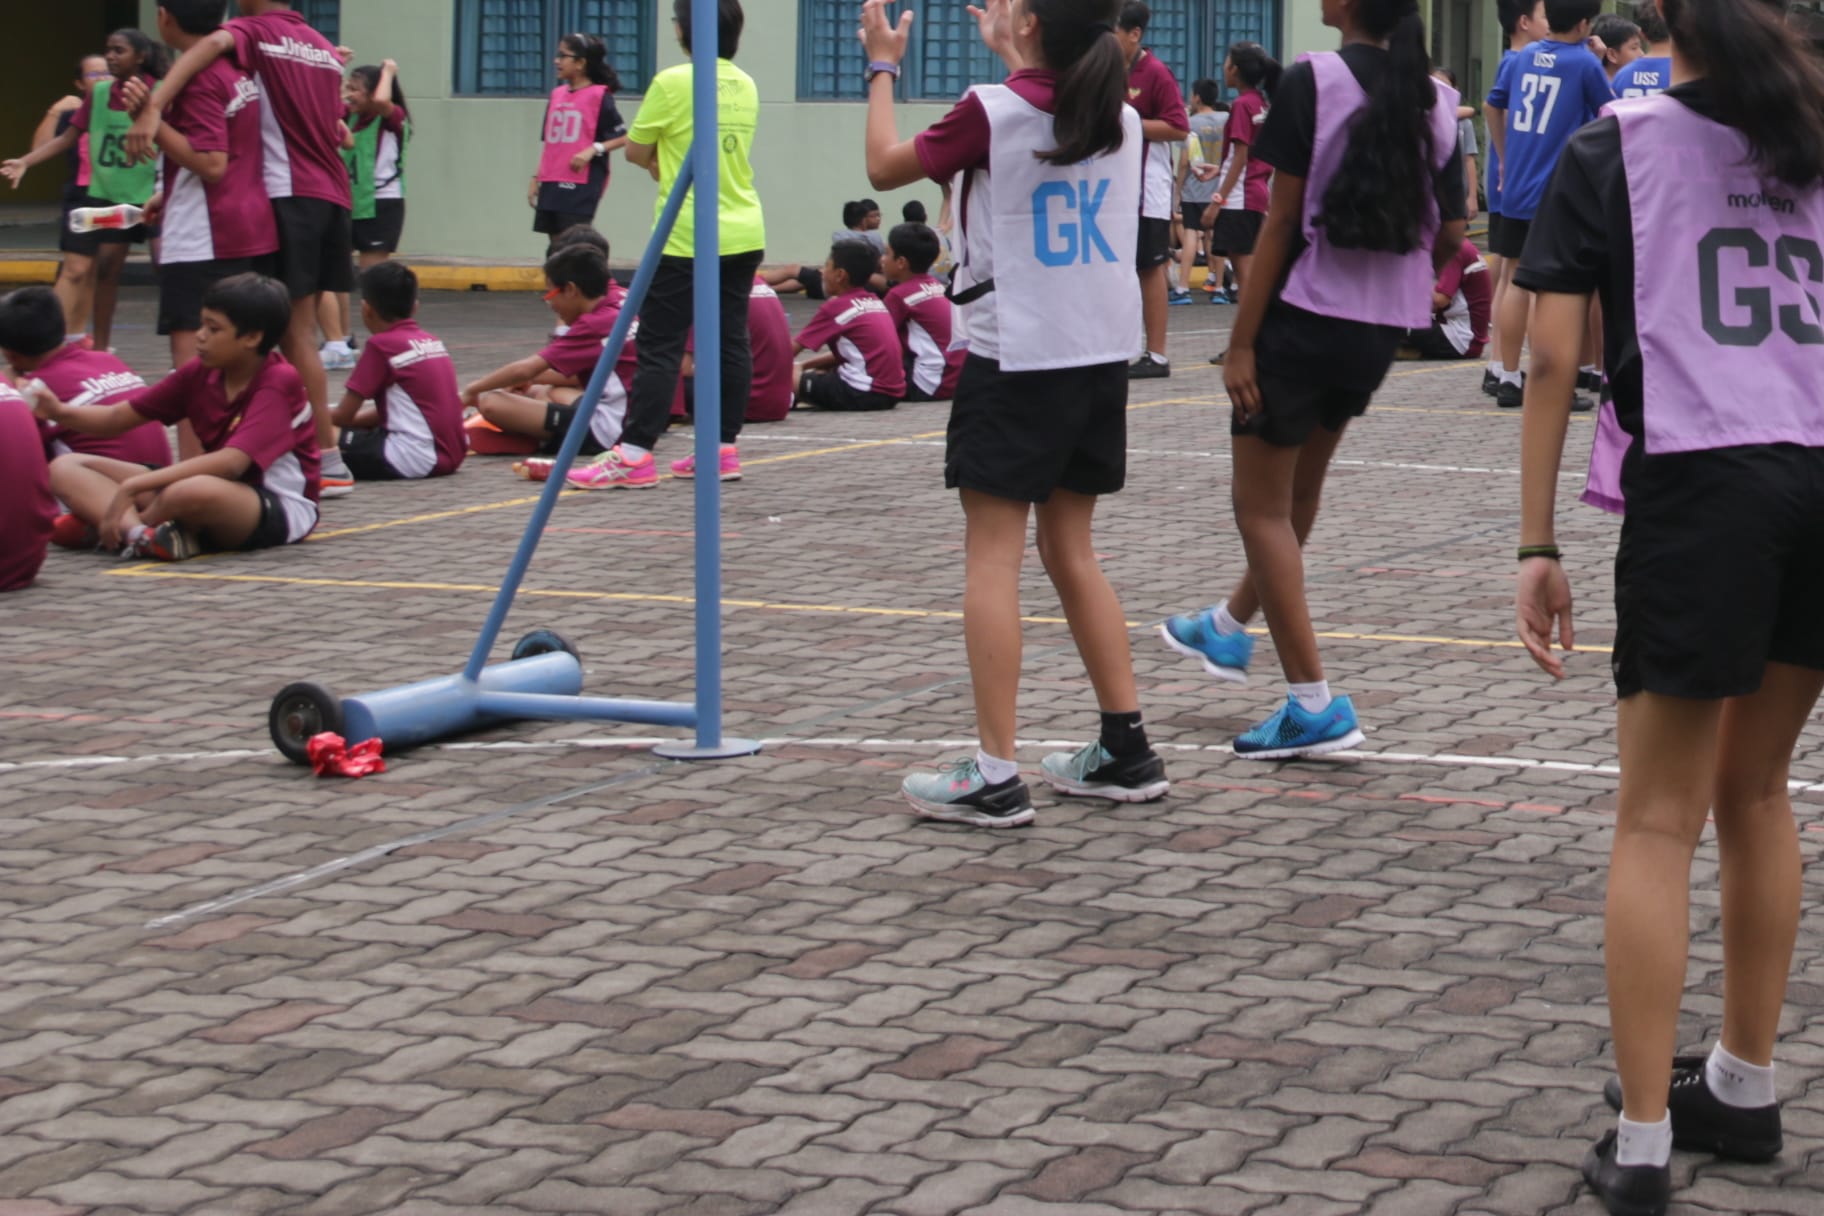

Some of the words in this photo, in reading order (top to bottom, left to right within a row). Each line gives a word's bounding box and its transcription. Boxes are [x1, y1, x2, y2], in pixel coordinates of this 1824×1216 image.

[1533, 52, 1557, 69] USS
[1633, 71, 1660, 85] USS
[1513, 73, 1562, 135] 37
[547, 109, 582, 144] GD
[1032, 179, 1119, 267] GK
